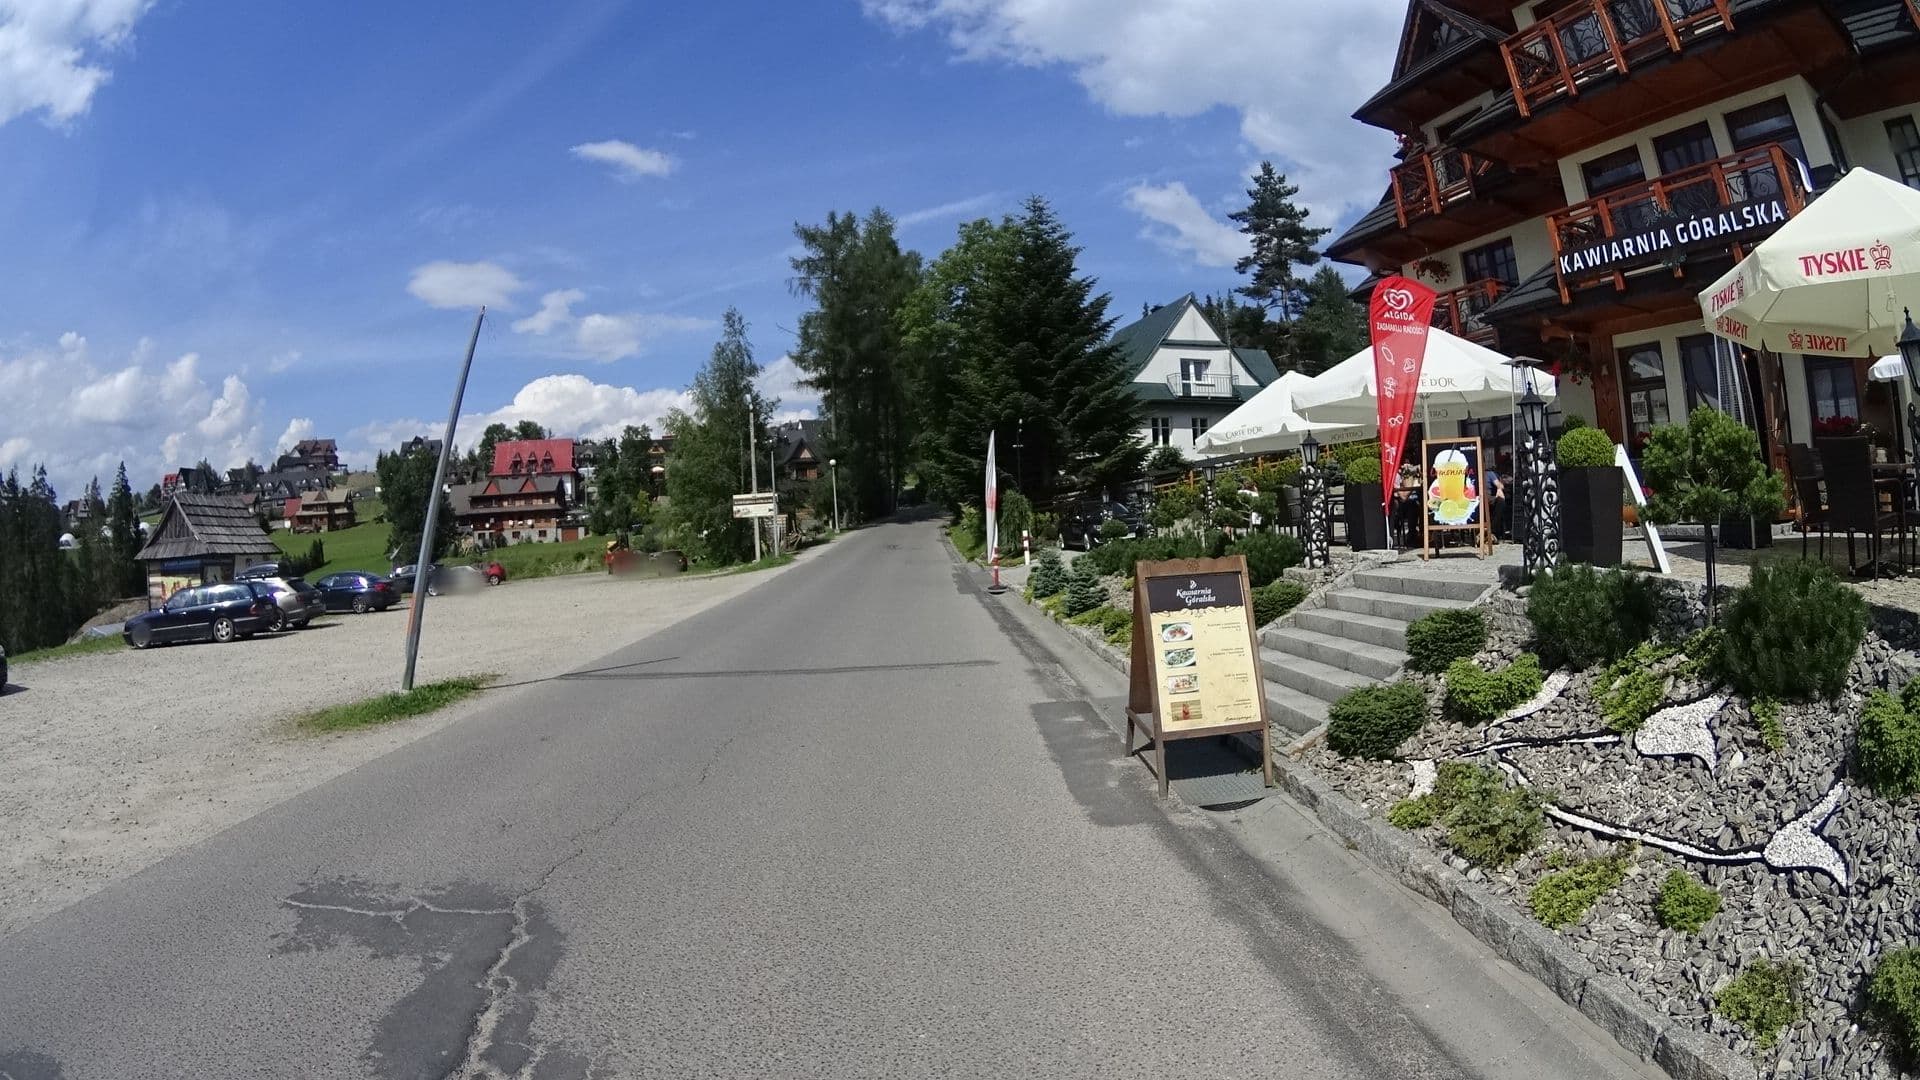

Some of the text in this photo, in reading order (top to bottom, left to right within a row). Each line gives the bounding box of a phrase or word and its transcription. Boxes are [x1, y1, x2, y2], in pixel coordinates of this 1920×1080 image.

[1560, 200, 1785, 274] KAWIARNIA GÓRALSKA
[1798, 248, 1869, 277] TYSKIE
[1711, 282, 1736, 313] TYSKIE
[1383, 310, 1415, 321] ALGIDA
